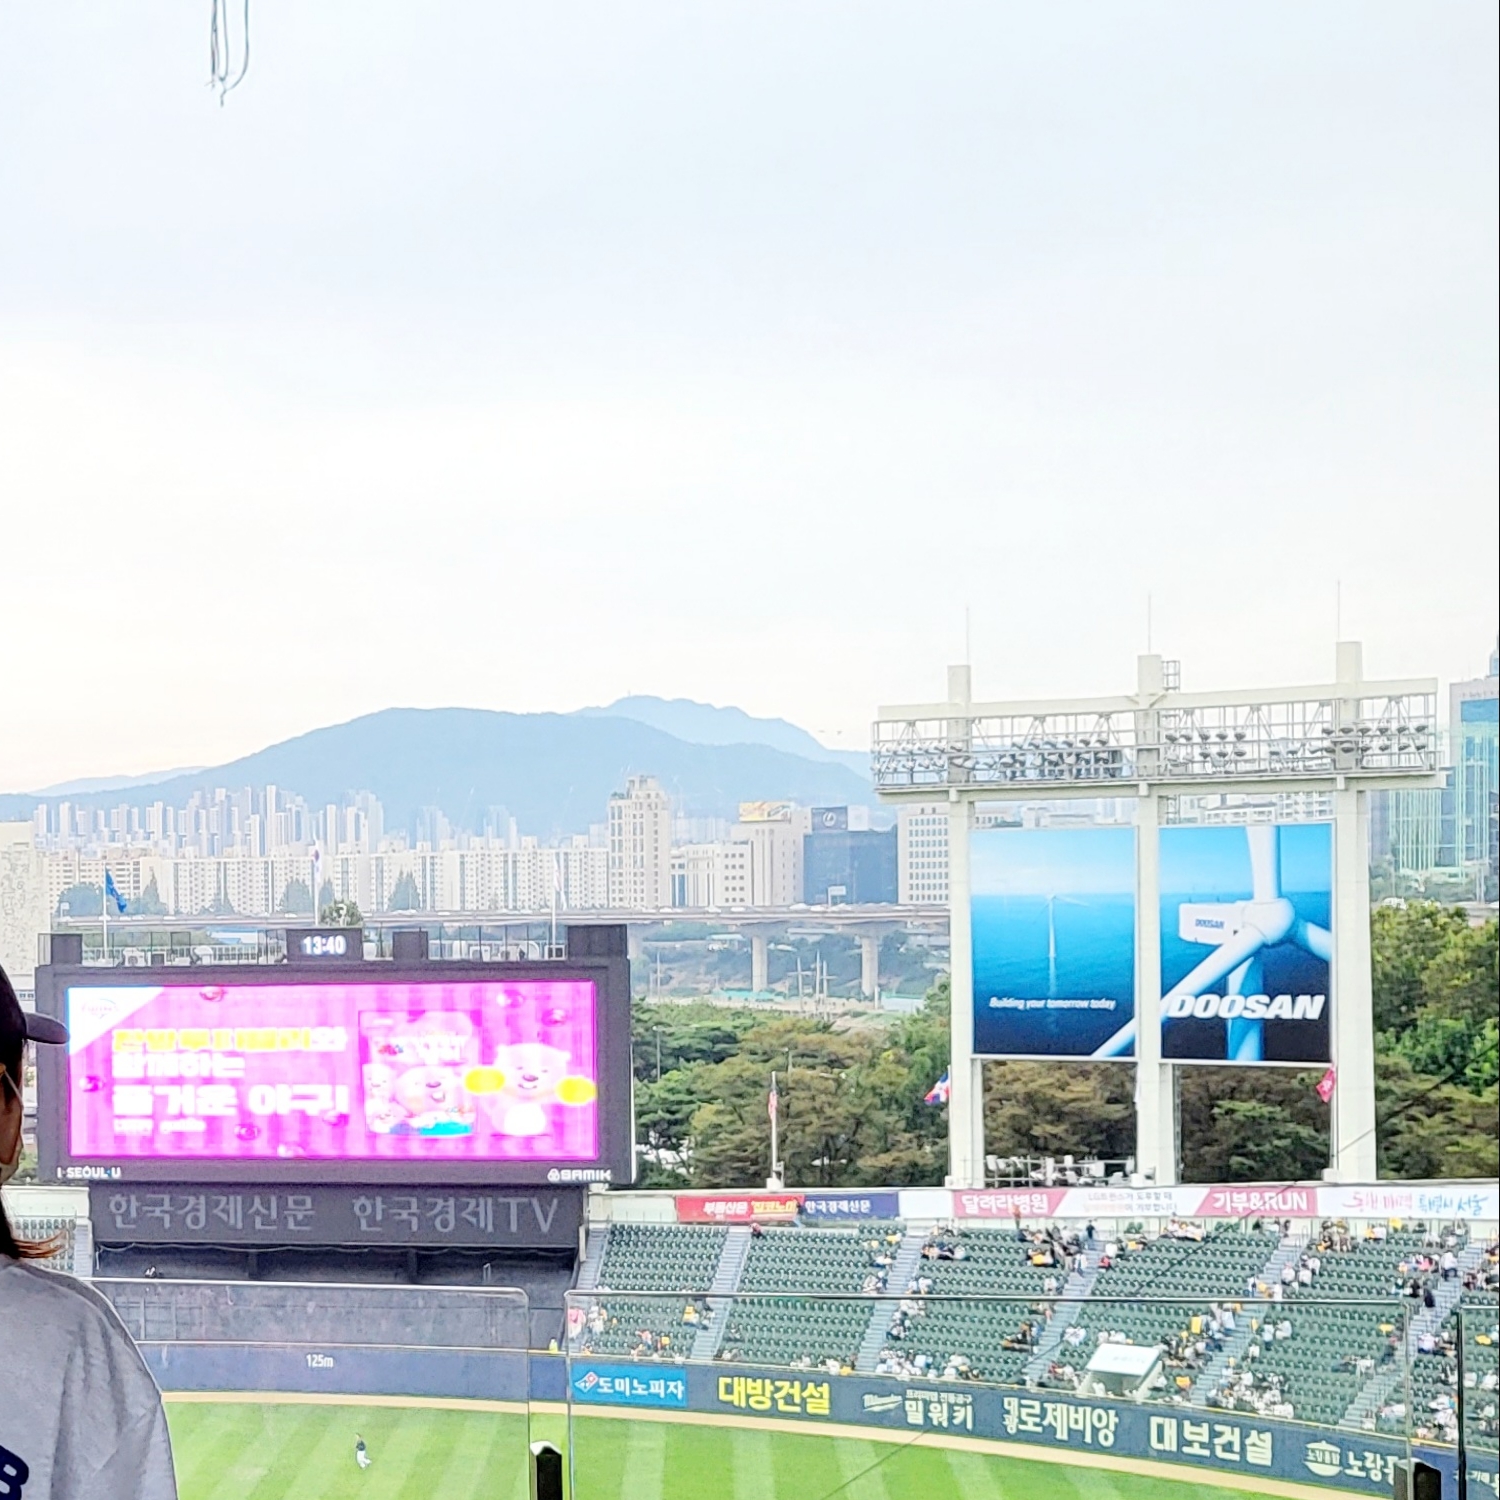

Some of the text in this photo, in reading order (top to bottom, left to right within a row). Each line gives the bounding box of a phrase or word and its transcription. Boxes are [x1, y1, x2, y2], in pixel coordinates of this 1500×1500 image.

[302, 935, 347, 955] 13:40
[1046, 998, 1090, 1009] tomorrow
[1089, 997, 1117, 1011] today
[1166, 993, 1326, 1021] DOOSAN
[109, 1193, 558, 1233] 한국경제신문 한국경제TV
[805, 1199, 871, 1214] 한국경제신문
[961, 1192, 1049, 1215] 달려라병원
[1212, 1190, 1308, 1213] 기부&RUN
[306, 1353, 334, 1369] 125m
[597, 1375, 686, 1400] 도미노피자
[717, 1376, 831, 1416] 대방건설
[904, 1400, 973, 1432] 밀워키
[1149, 1415, 1273, 1467] 대보건설
